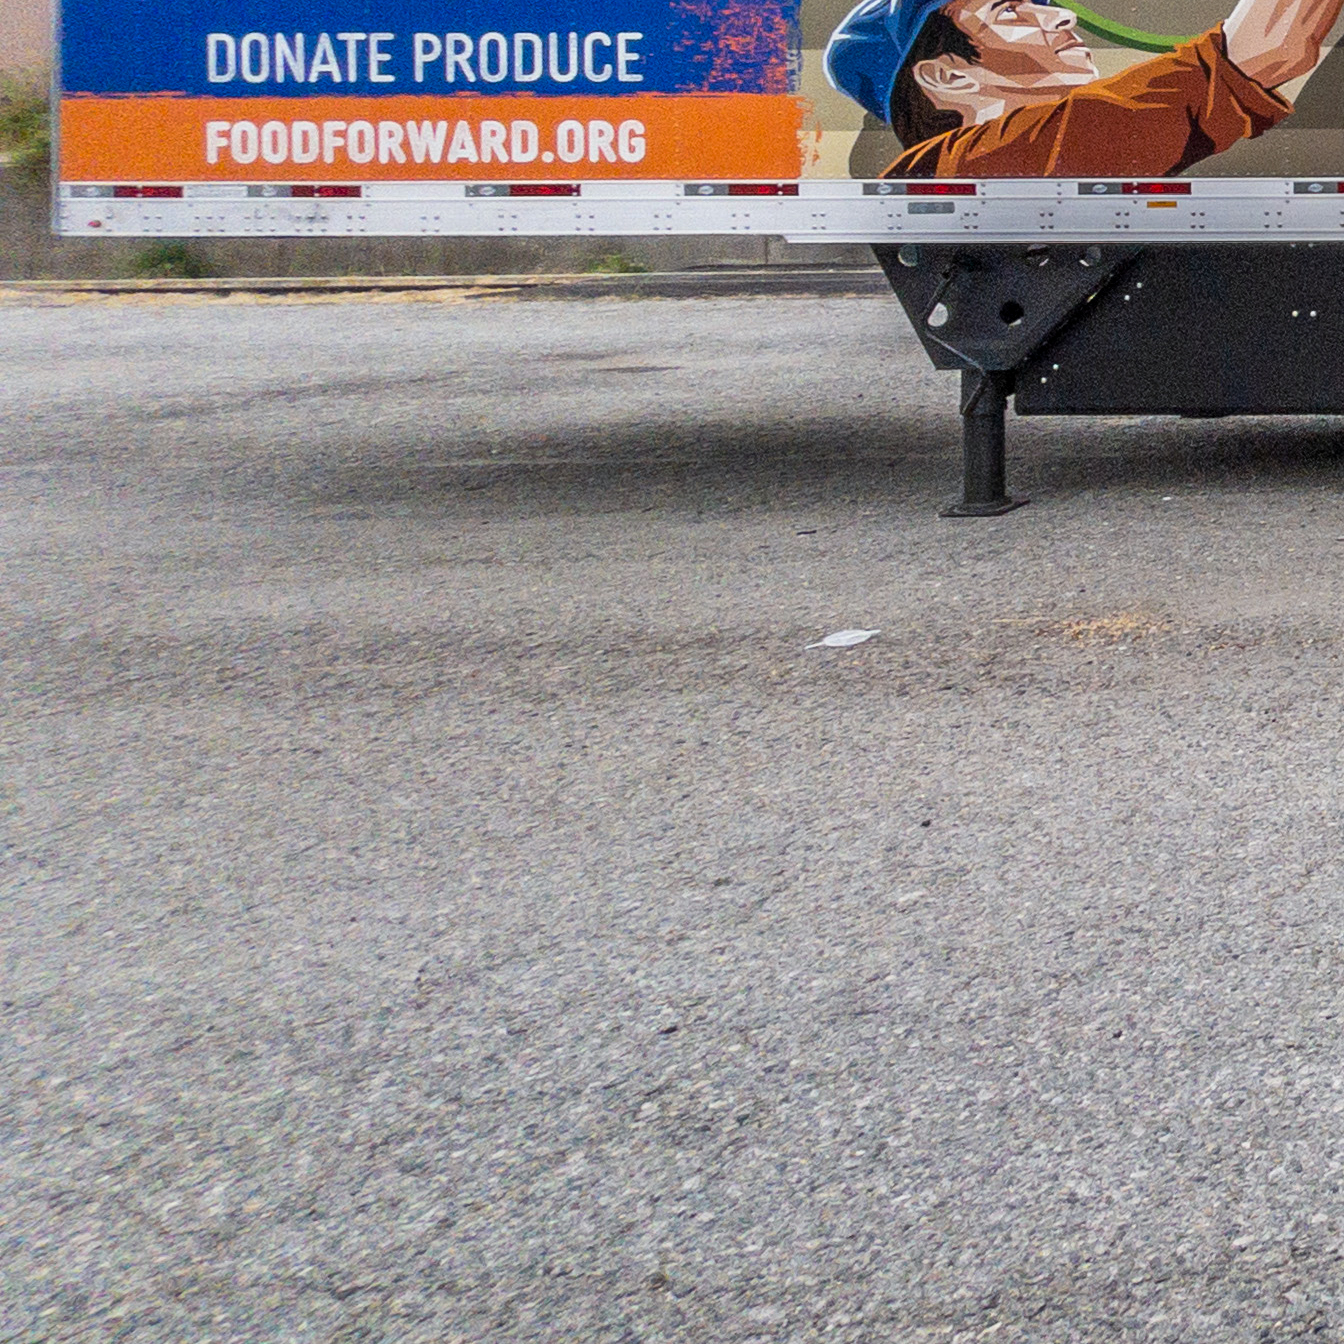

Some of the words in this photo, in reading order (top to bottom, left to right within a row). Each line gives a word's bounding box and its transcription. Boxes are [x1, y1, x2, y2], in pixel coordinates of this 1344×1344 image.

[206, 32, 396, 86] DONATE
[414, 32, 645, 84] PRODUCE
[206, 120, 647, 165] FOODFORWARD.ORG
